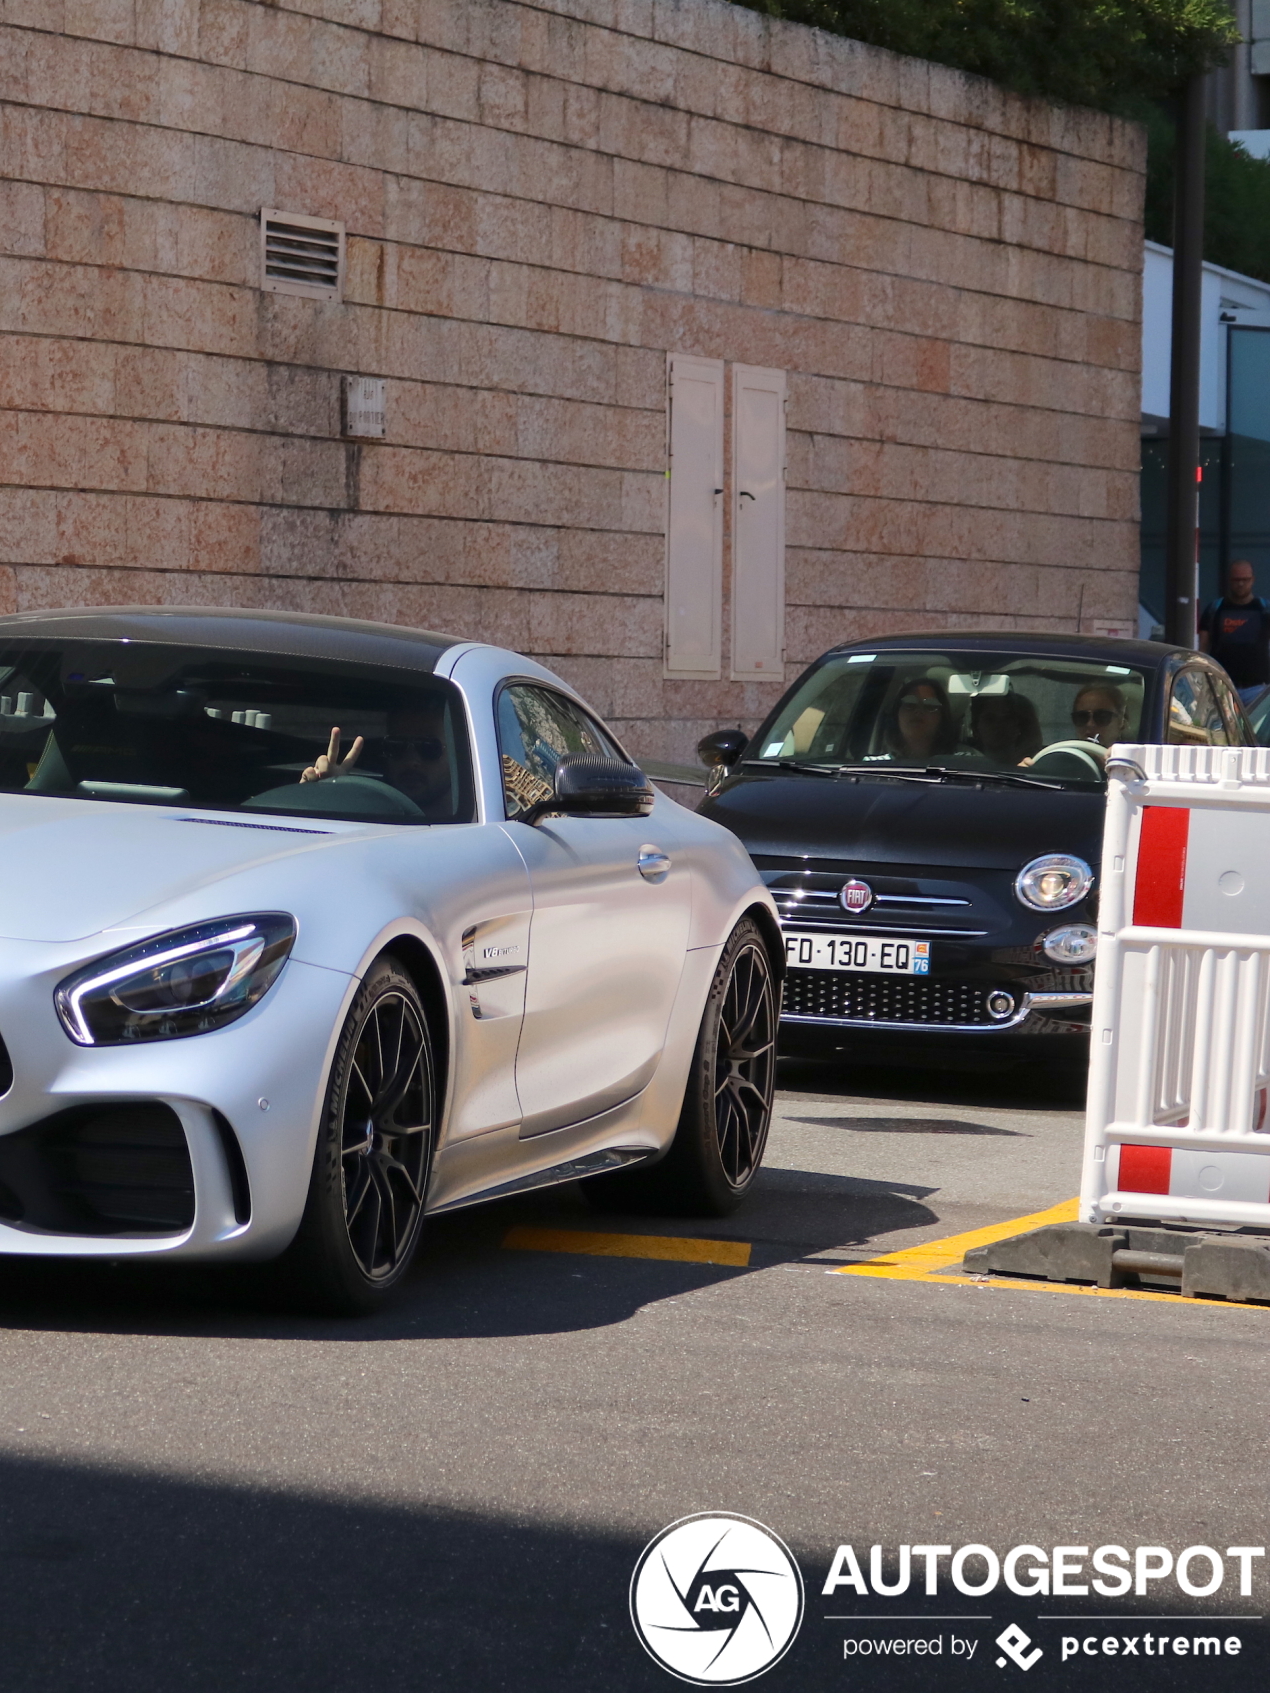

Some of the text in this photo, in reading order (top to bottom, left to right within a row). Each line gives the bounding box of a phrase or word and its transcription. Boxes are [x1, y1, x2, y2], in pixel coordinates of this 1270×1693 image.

[847, 889, 866, 905] FIAT
[914, 958, 928, 972] 76
[331, 1016, 358, 1111] MICHELIN
